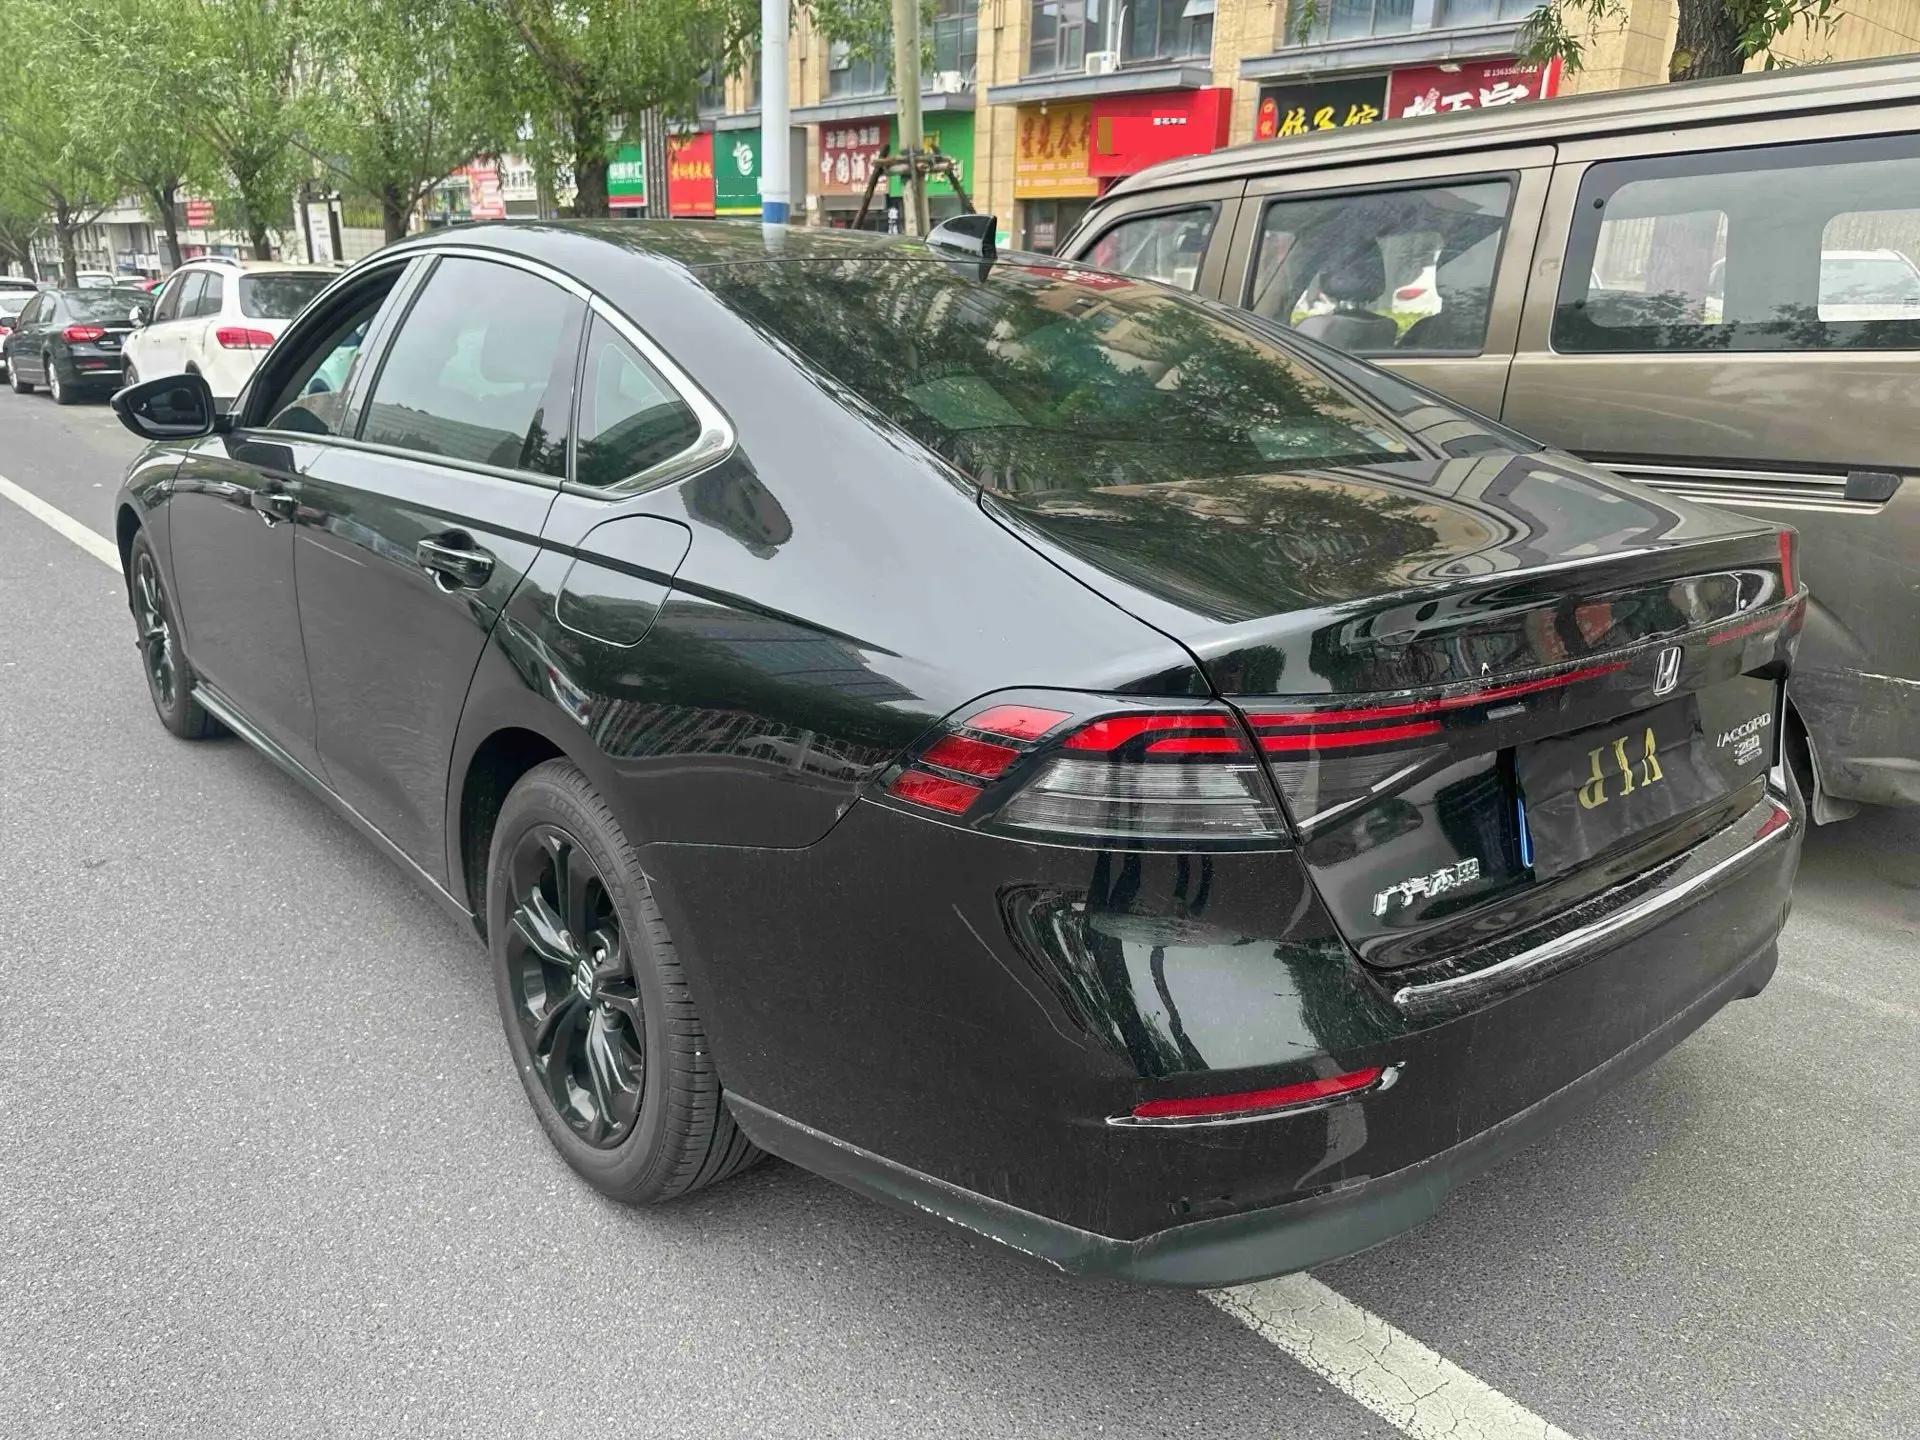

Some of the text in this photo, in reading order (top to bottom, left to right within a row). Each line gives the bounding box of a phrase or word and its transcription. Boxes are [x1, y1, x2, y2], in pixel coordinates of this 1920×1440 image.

[1578, 728, 1663, 809] VIP
[1372, 857, 1480, 916] 广汽本田
